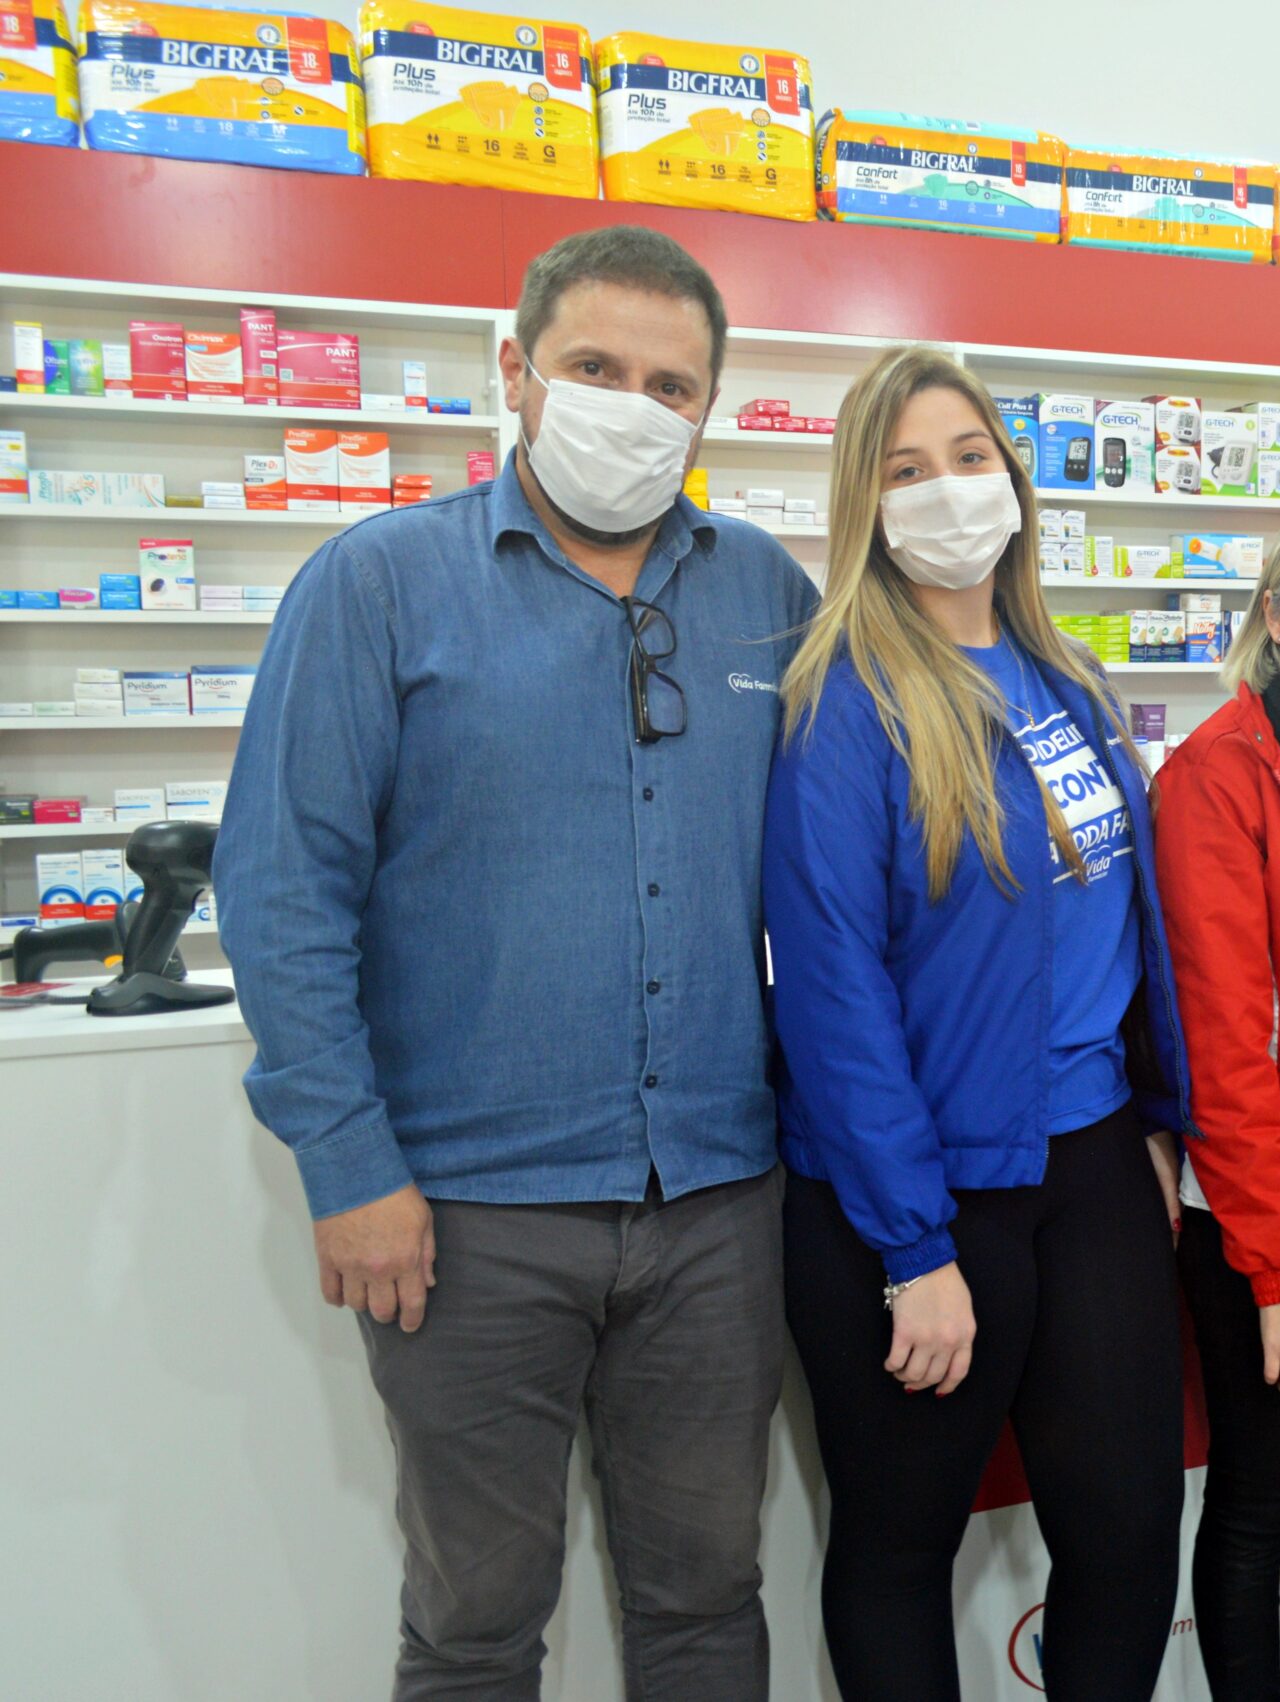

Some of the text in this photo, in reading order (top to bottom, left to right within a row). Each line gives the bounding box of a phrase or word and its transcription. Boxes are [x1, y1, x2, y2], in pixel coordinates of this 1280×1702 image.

[2, 15, 19, 33] 18
[161, 39, 281, 74] BIGFRAL
[436, 38, 539, 73] BIGFRAL
[555, 52, 570, 70] 16
[111, 63, 156, 80] Plus
[393, 62, 437, 82] Plus
[667, 69, 761, 100] BIGFRAL
[776, 79, 789, 96] 16
[627, 93, 667, 110] Plus
[483, 139, 500, 152] 16
[543, 144, 556, 158] G
[910, 150, 977, 173] BIGFRAL
[710, 163, 726, 176] 16
[765, 168, 777, 181] G
[856, 166, 899, 180] Confort
[1131, 174, 1194, 196] BIGFRAL
[1085, 190, 1123, 203] Confort
[325, 347, 357, 359] PANT
[1051, 404, 1084, 414] G-TECH
[1102, 414, 1139, 426] G-TECH
[1205, 418, 1234, 428] G-TECH
[127, 681, 168, 692] Pyridium
[194, 678, 238, 689] Pyridium
[732, 678, 753, 689] Vida
[1047, 760, 1108, 809] CON
[1086, 856, 1112, 877] Vida
